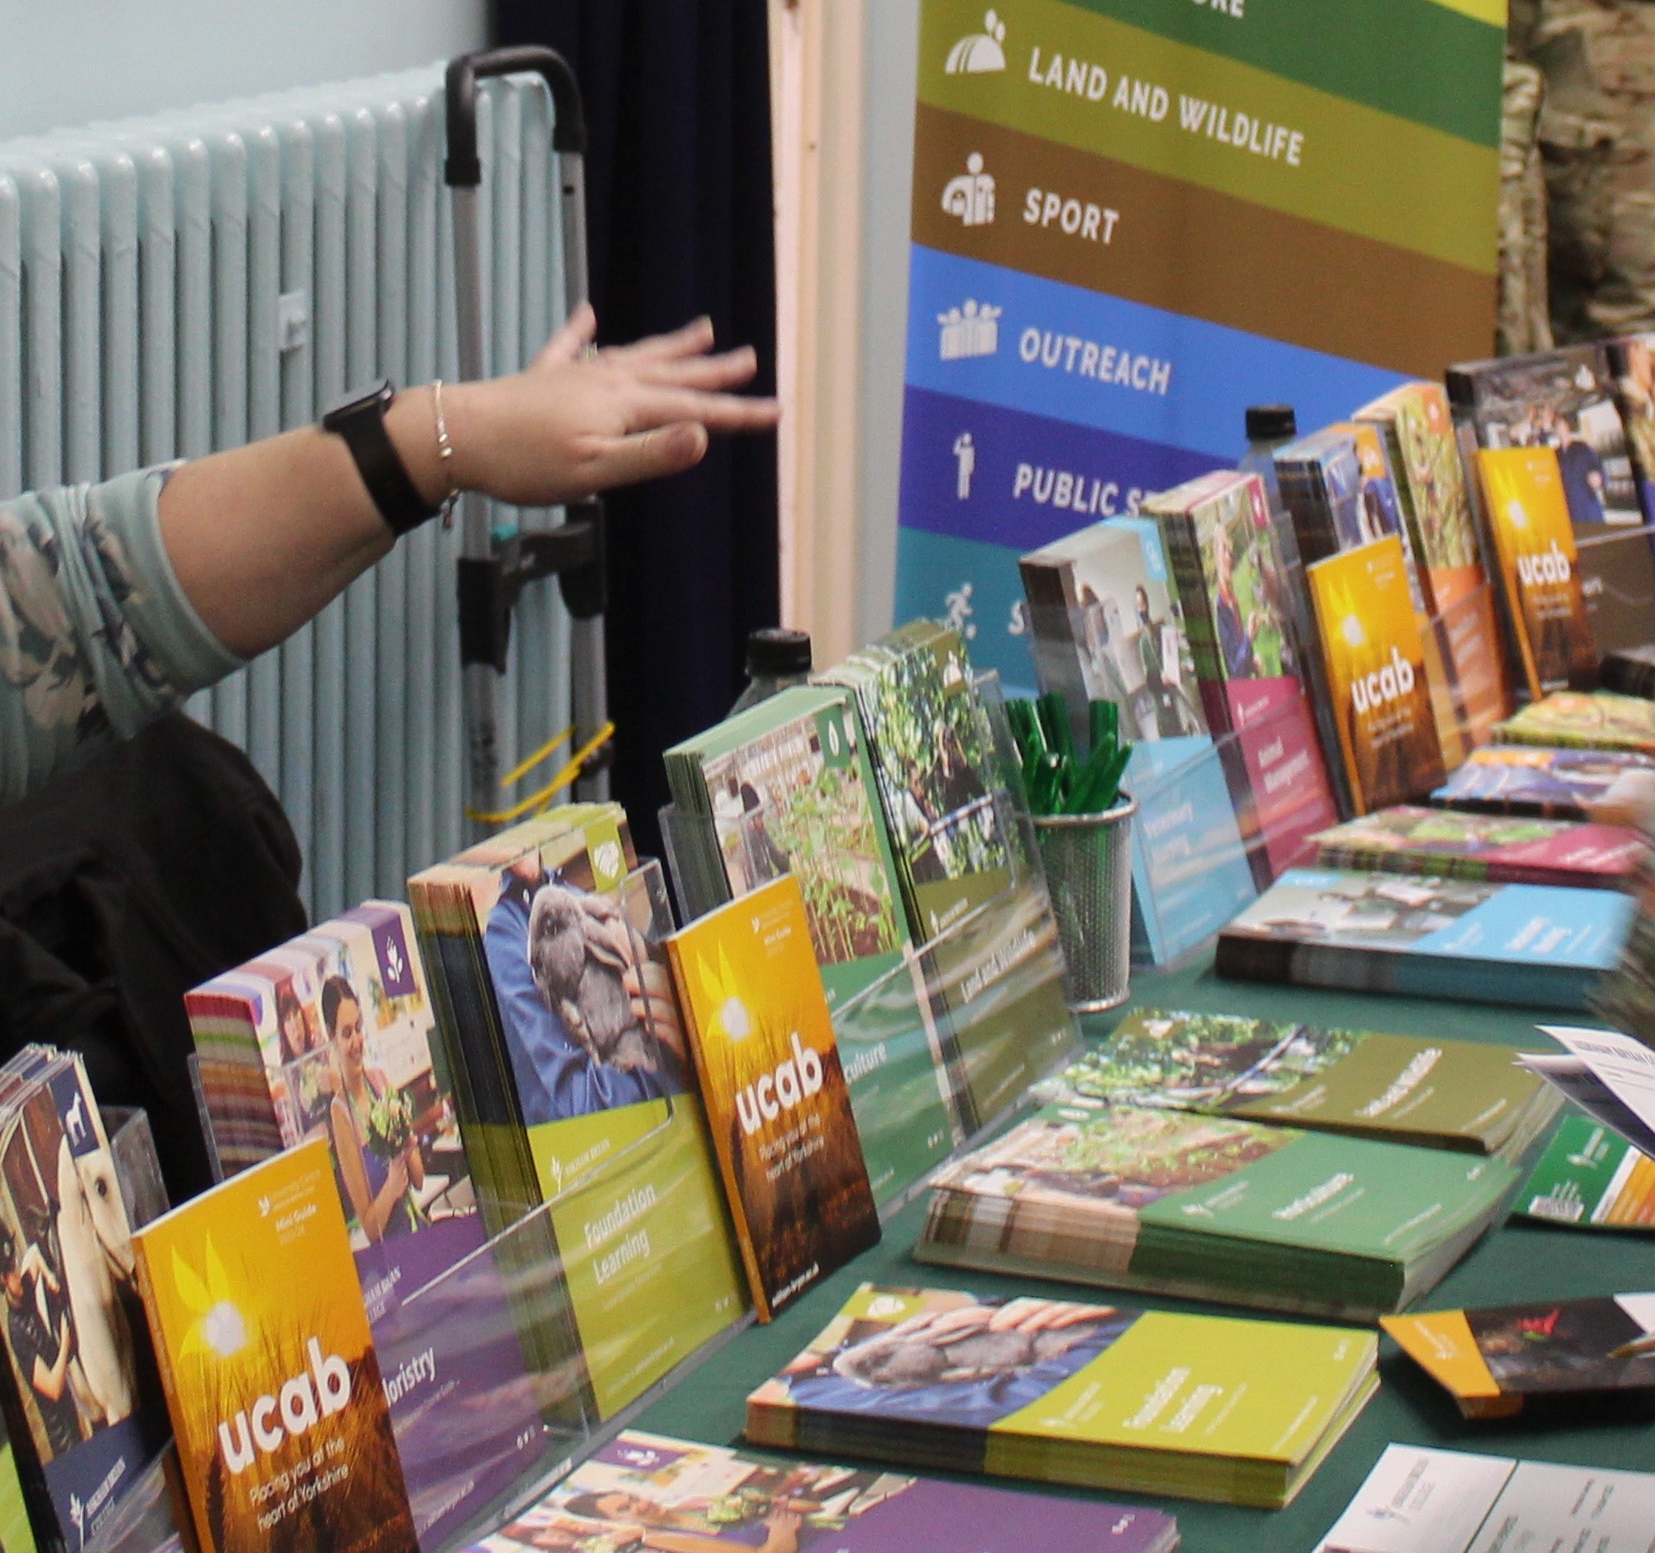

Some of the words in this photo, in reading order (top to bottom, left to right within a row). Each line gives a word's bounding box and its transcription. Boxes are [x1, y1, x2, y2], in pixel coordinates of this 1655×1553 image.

[1027, 46, 1108, 101] LAND
[1113, 76, 1170, 121] AND
[1178, 93, 1305, 167] WILDLIFE
[1021, 186, 1120, 245] SPORT
[1018, 327, 1173, 396] OUTREACH
[1012, 462, 1119, 517] PUBLIC
[1516, 538, 1571, 587] ucab
[1350, 645, 1415, 715] ucab
[735, 1031, 824, 1136] ucab
[584, 1183, 657, 1251] Foundation
[593, 1227, 651, 1286] Learning
[218, 1335, 352, 1475] ucab
